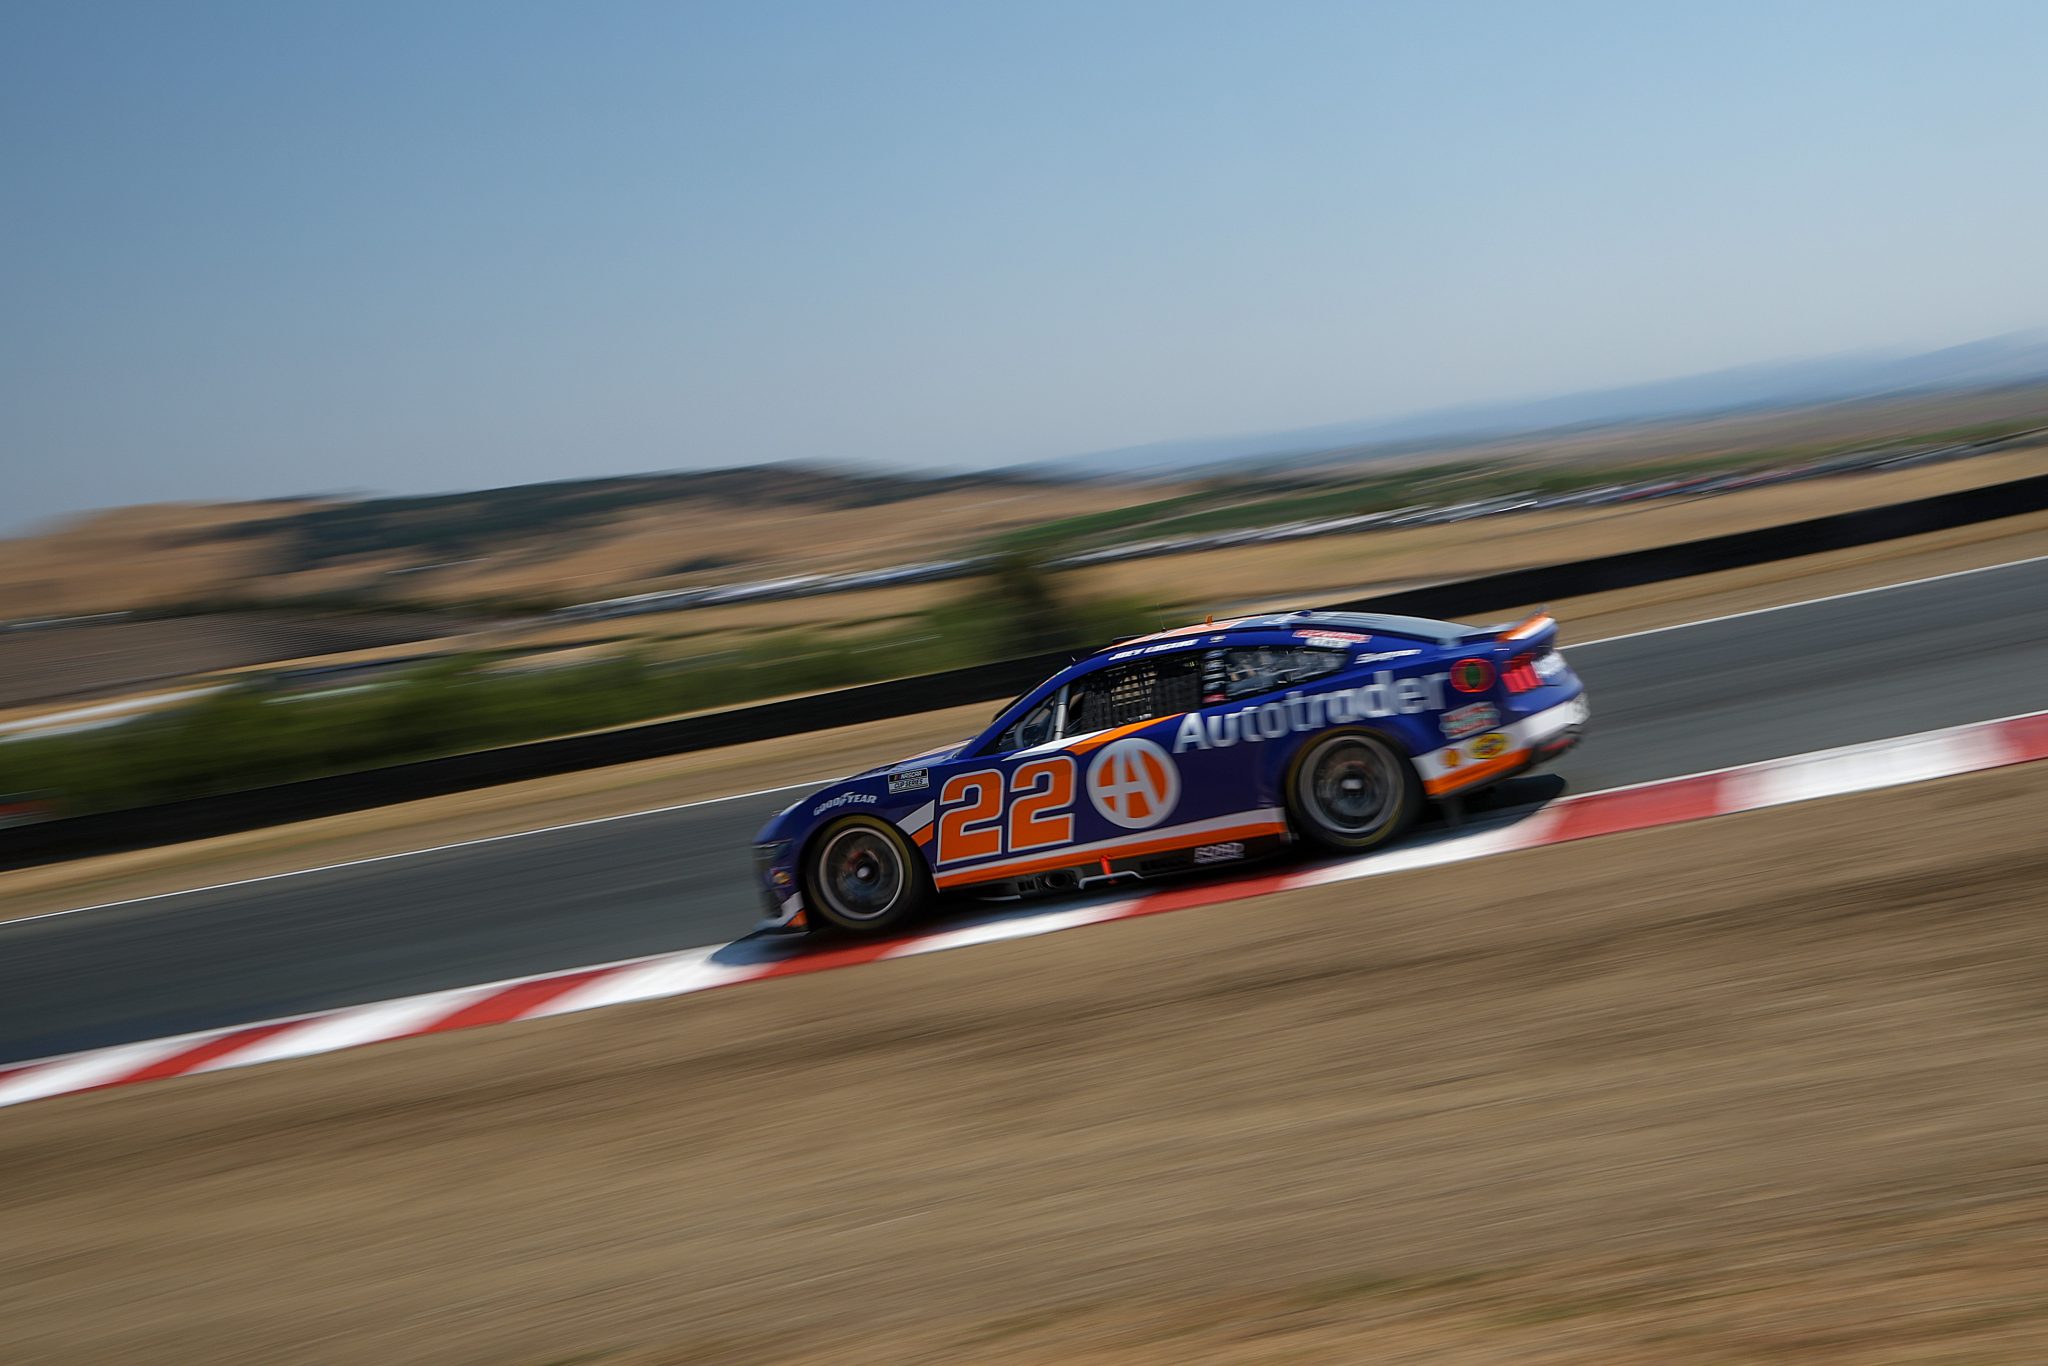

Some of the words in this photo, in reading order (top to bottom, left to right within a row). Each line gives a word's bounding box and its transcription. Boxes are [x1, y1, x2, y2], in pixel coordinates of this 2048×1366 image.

[1172, 670, 1452, 754] Autotrader
[813, 791, 878, 816] GOODYEAR
[936, 755, 1078, 866] 22
